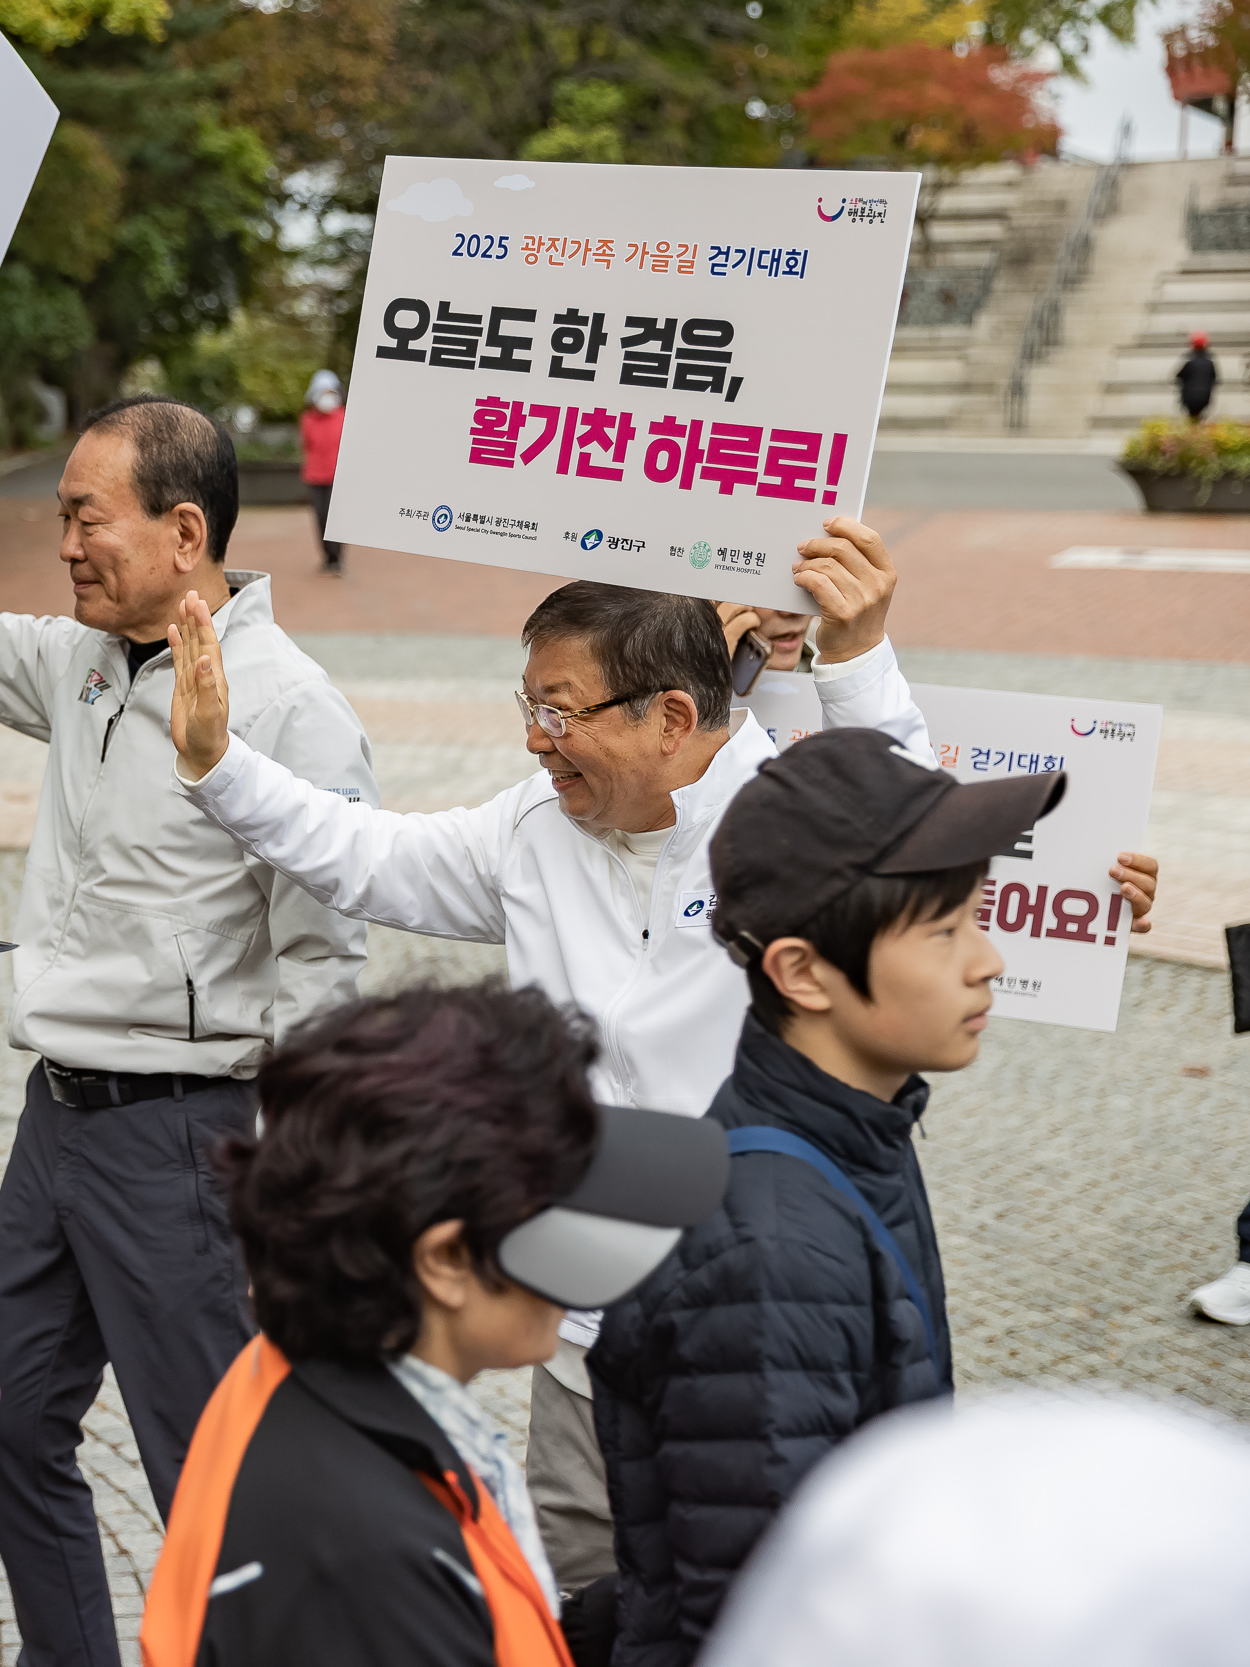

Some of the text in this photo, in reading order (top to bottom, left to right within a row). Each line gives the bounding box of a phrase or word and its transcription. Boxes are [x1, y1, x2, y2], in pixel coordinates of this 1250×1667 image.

[847, 206, 887, 224] 행복광진
[452, 233, 809, 279] 2025 광진가족 가을길 걷기대회
[375, 297, 745, 403] 오늘도 한 걸음,
[468, 396, 849, 506] 활기찬 하루로!
[399, 507, 430, 521] 주최/주관
[457, 511, 493, 526] 서울특별시
[495, 517, 538, 532] 광진구체육회
[562, 531, 578, 542] 후원
[606, 536, 646, 553] 광진구
[669, 545, 685, 558] 협찬
[716, 547, 767, 567] 혜민병원
[714, 563, 762, 576] HYEMIN HOSPITAL
[970, 746, 1065, 774] 걷기대회
[976, 878, 1123, 947] 어요!
